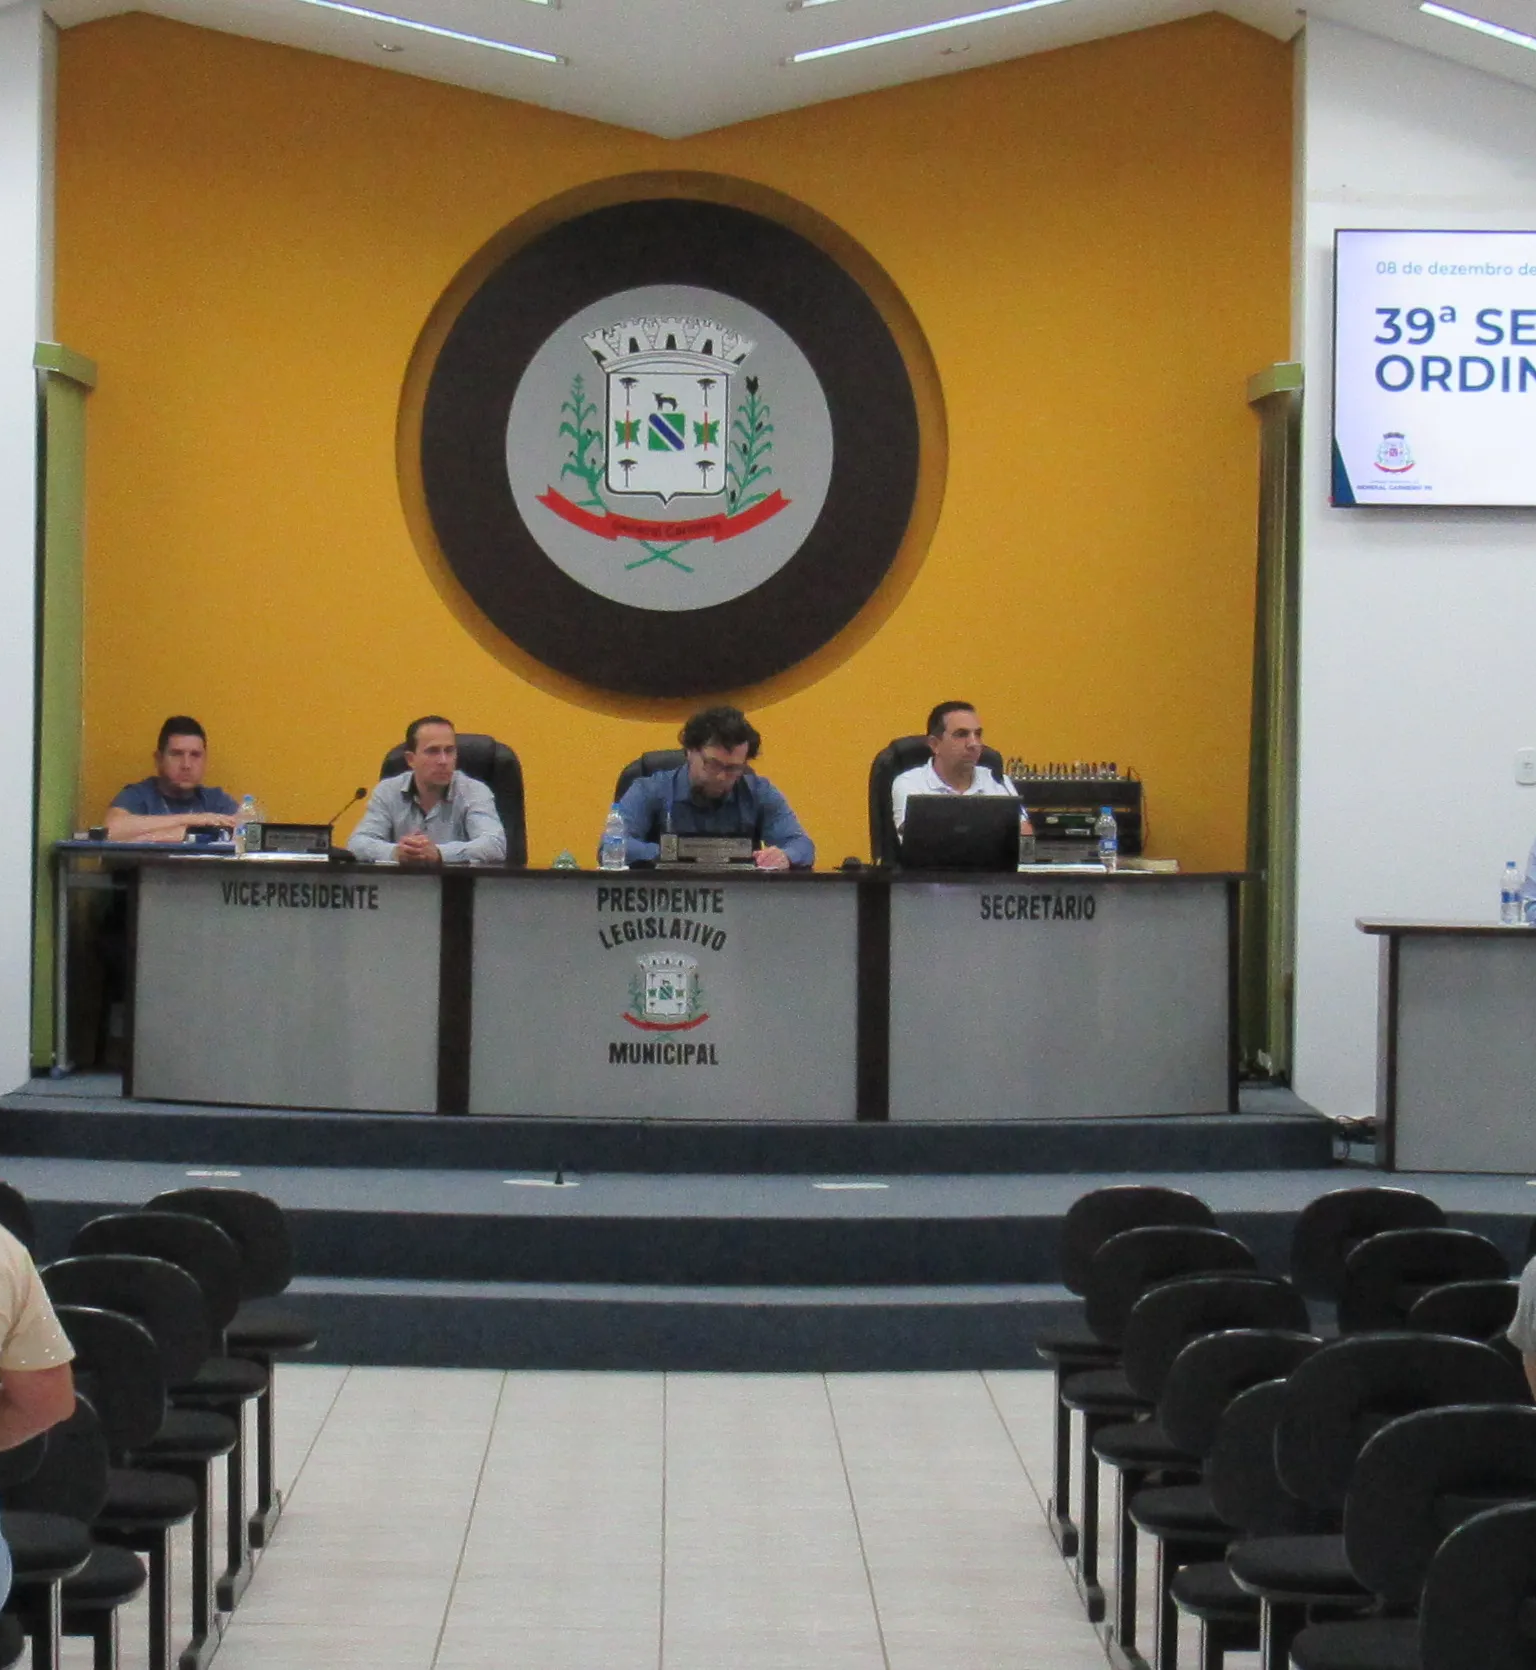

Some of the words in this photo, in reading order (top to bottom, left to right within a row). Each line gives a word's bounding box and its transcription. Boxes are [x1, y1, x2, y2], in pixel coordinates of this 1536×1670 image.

[1375, 260, 1397, 275] 08
[1402, 261, 1423, 275] de
[1427, 261, 1514, 276] dezembro
[1373, 304, 1457, 346] 39ª
[221, 880, 380, 911] VICE-PRESIDENTE
[596, 886, 725, 914] PRESIDENTE
[597, 915, 728, 952] LEGISLATIVO
[608, 1041, 720, 1066] MUNICIPAL
